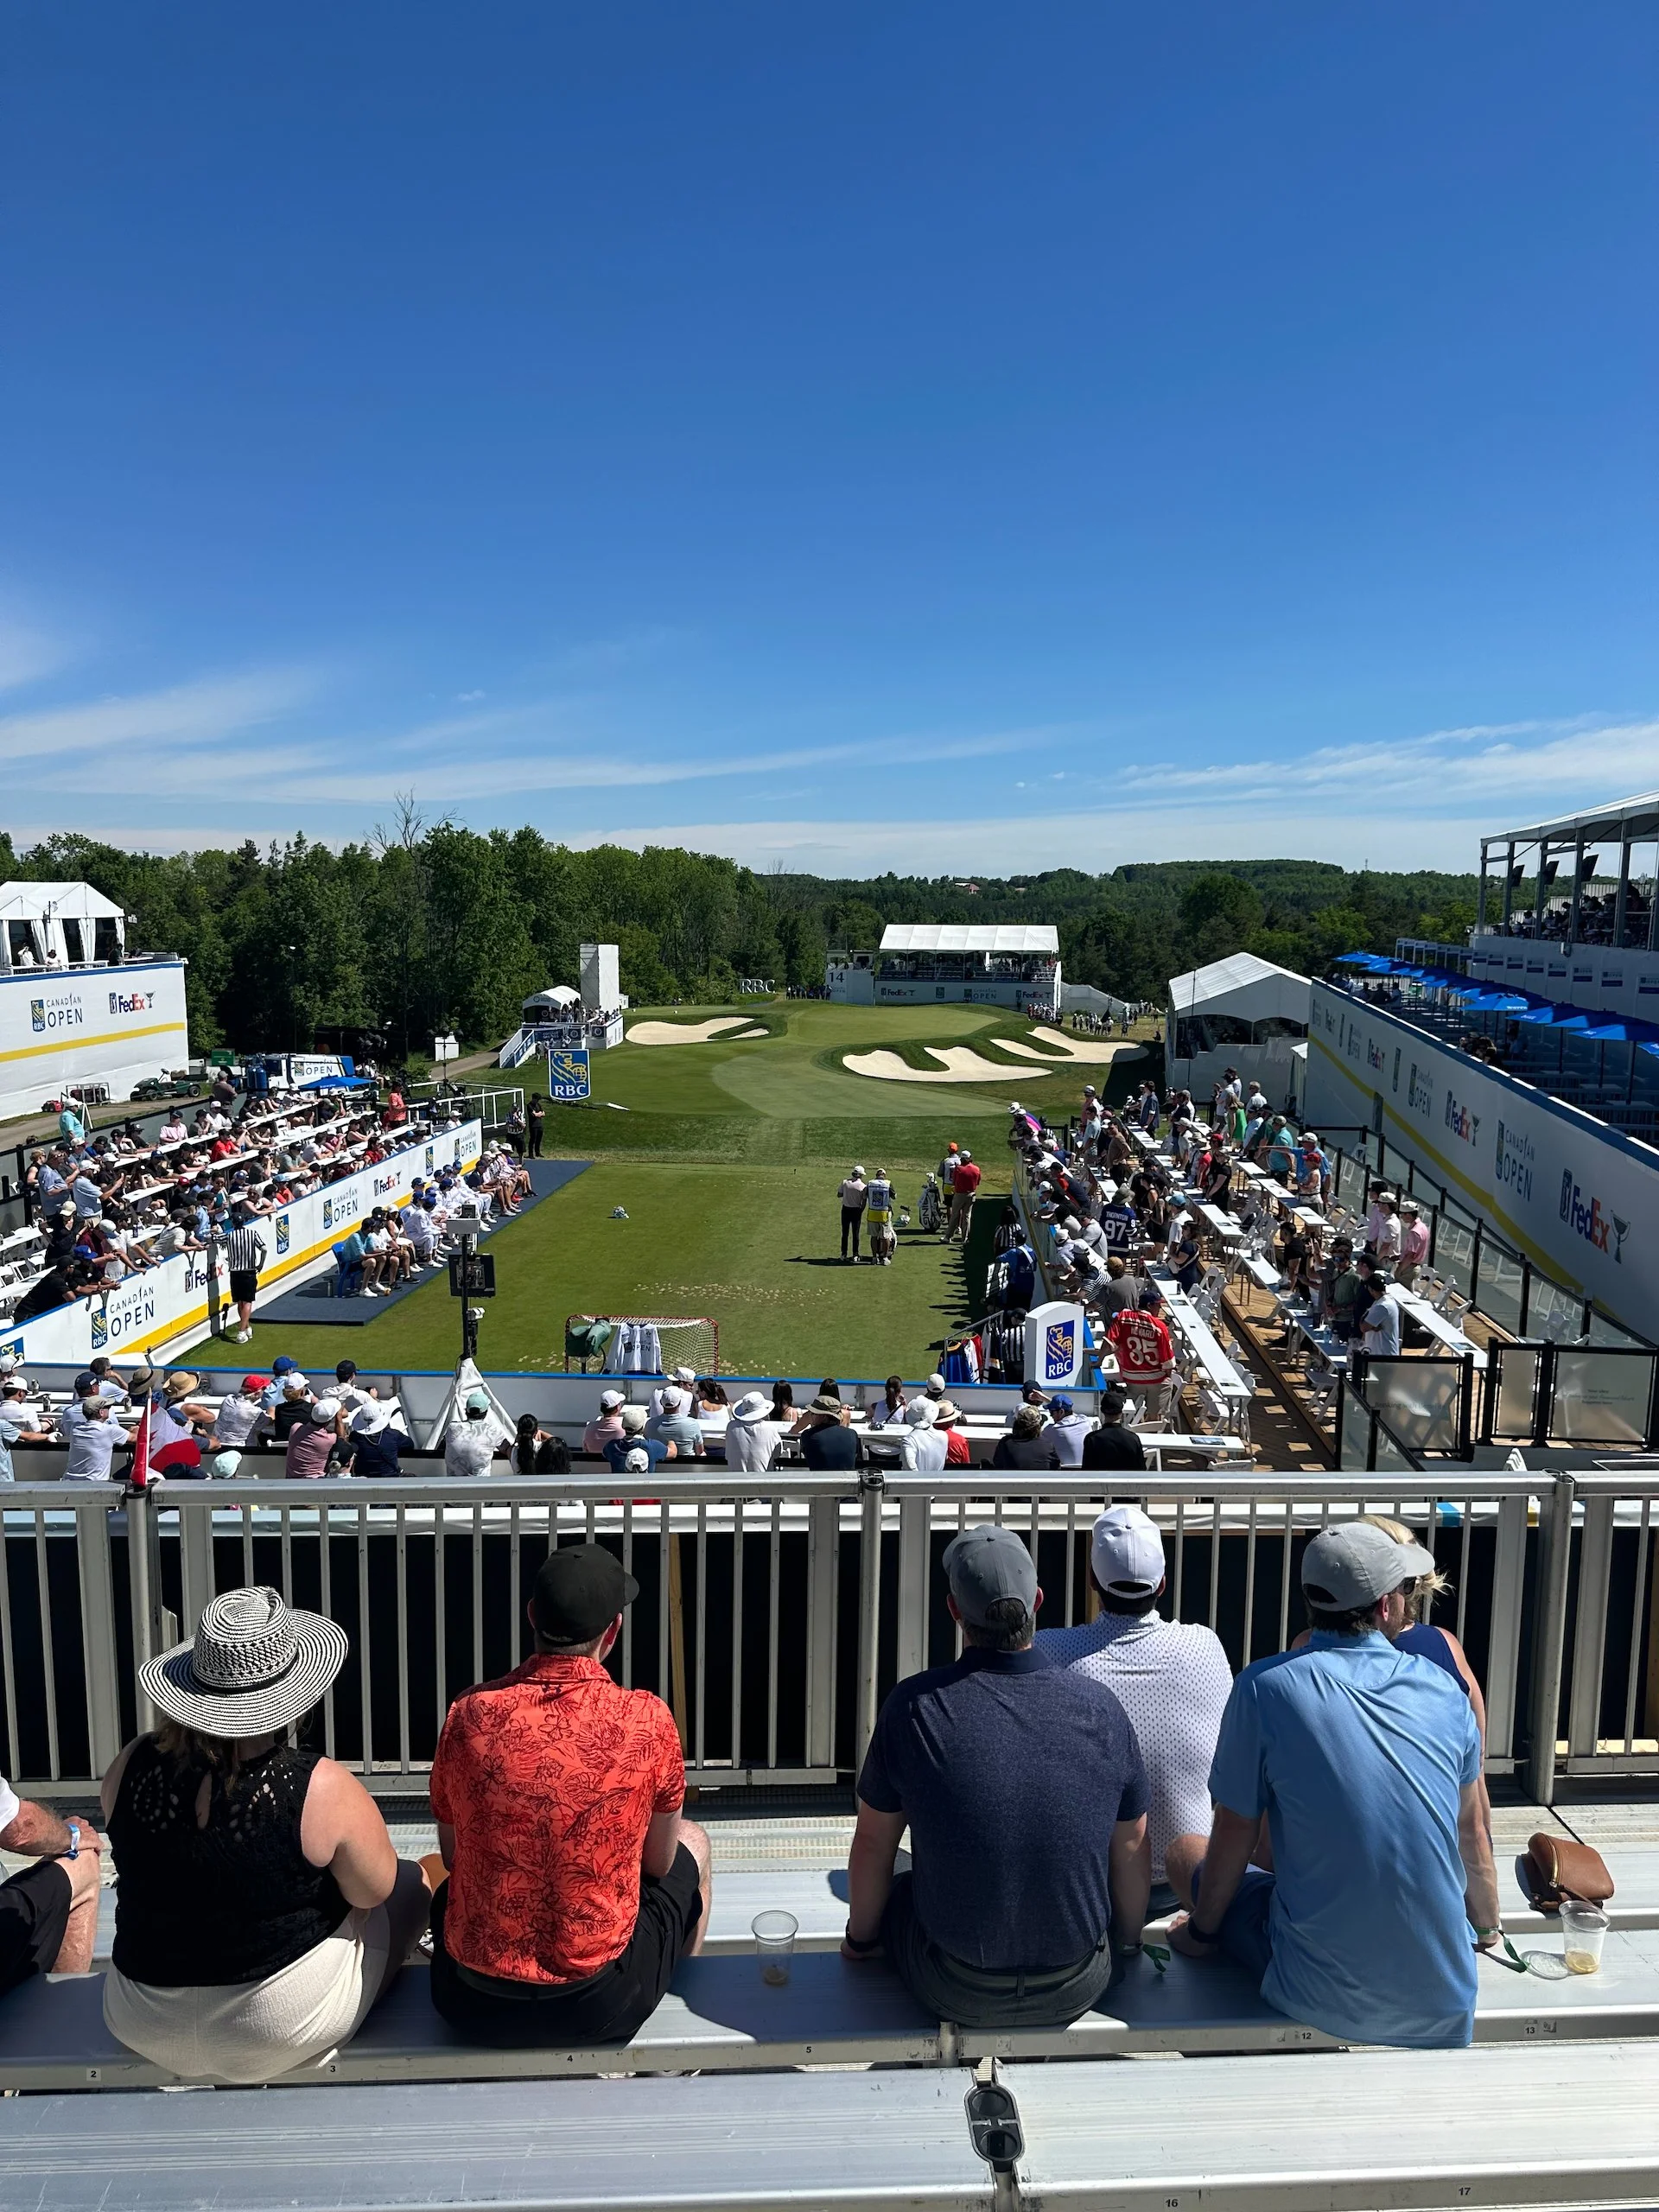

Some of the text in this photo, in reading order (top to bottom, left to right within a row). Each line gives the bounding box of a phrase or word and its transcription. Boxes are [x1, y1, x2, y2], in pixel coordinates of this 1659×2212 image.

[740, 978, 776, 994] RBC
[830, 972, 844, 982] 14
[47, 993, 82, 1007] CANADIAN
[118, 994, 145, 1013] FedEx
[34, 1021, 45, 1030] RBC
[48, 1008, 83, 1027] OPEN
[306, 1065, 333, 1075] OPEN
[554, 1084, 587, 1096] RBC
[1415, 1086, 1432, 1118] OPEN
[1451, 1099, 1470, 1142] FedEx
[461, 1139, 477, 1157] OPEN
[1505, 1128, 1535, 1161] CANADIAN
[380, 1175, 396, 1193] FedEx
[1503, 1153, 1533, 1202] OPEN
[334, 1187, 358, 1205] CANADIAN
[334, 1198, 358, 1222] OPEN
[922, 1194, 931, 1226] PING
[1571, 1185, 1610, 1253] FedEx
[1105, 1219, 1127, 1241] 97
[278, 1238, 289, 1253] RBC
[195, 1264, 224, 1288] FedEx
[110, 1284, 154, 1313] CANADIAN
[111, 1300, 155, 1337] OPEN
[92, 1334, 107, 1348] RBC
[1127, 1337, 1159, 1366] 35
[1048, 1359, 1071, 1377] RBC
[1301, 2031, 1312, 2040] 12
[1459, 2187, 1471, 2196] 17
[1165, 2199, 1179, 2209] 16
